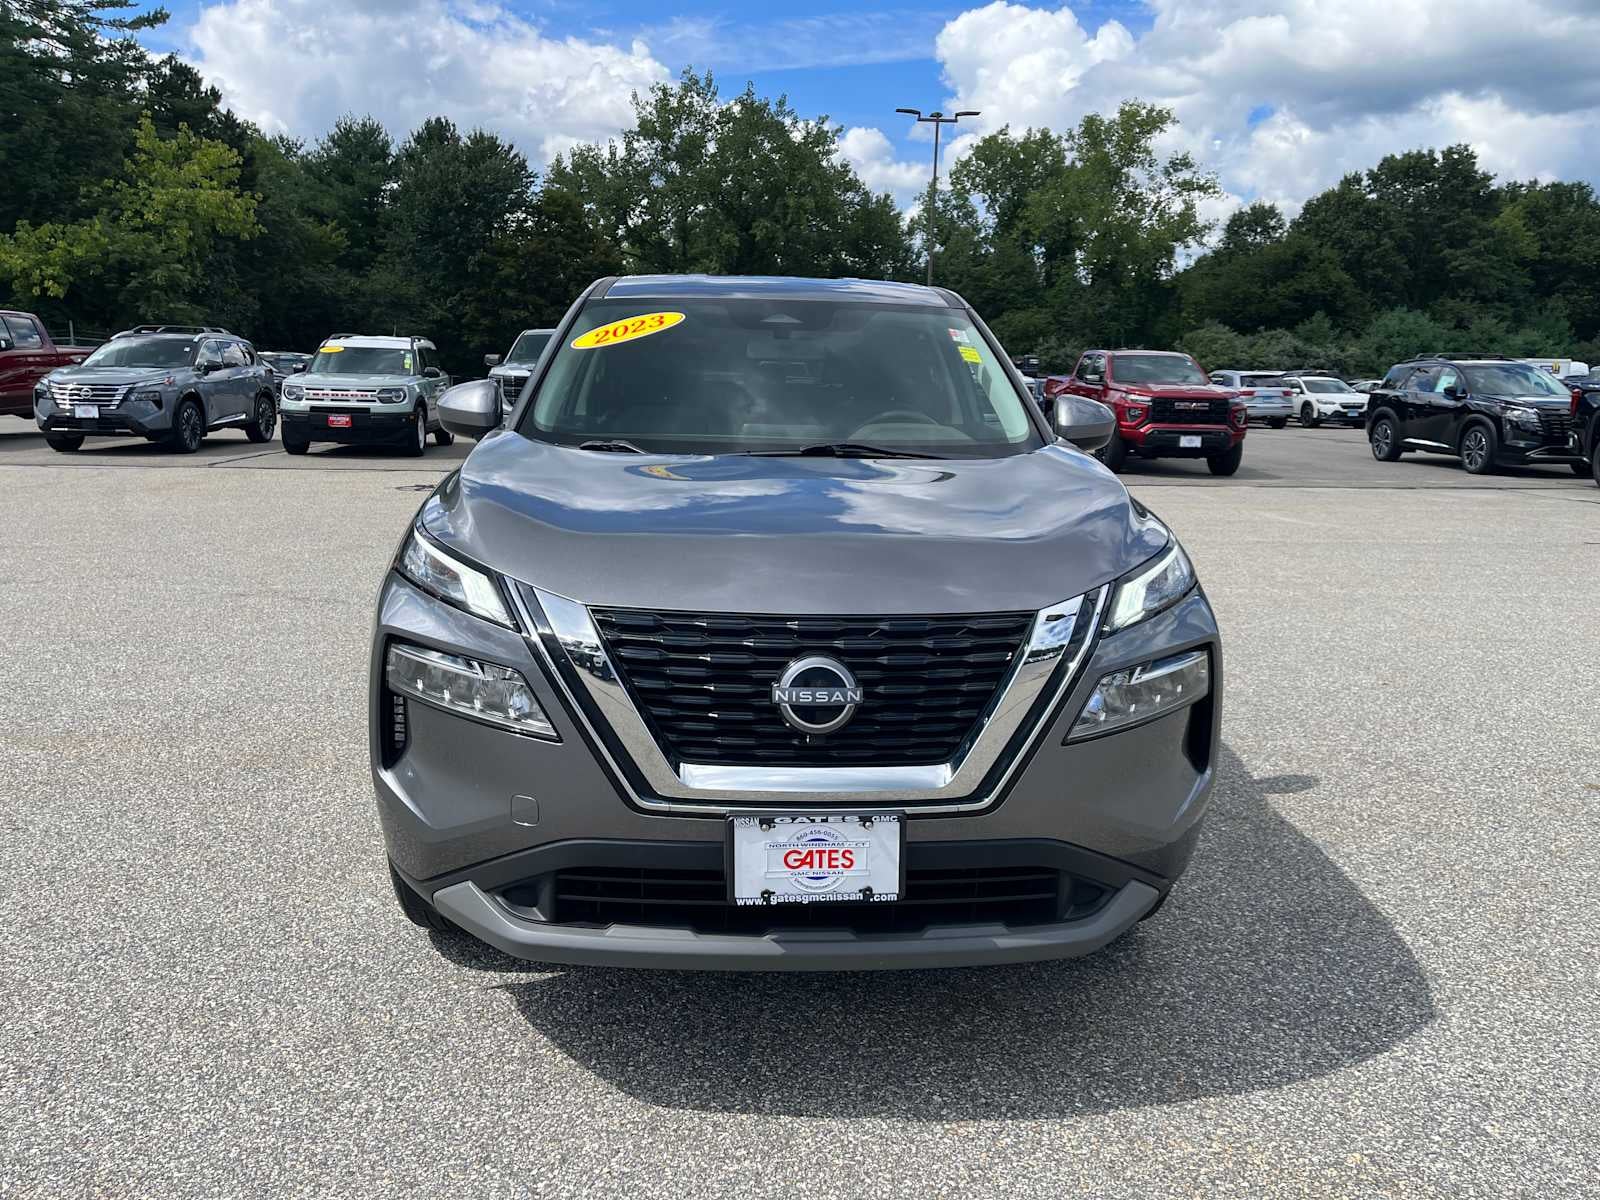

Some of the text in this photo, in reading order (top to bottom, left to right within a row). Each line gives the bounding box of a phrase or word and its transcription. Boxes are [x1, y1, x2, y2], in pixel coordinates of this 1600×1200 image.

[594, 315, 665, 344] 2023
[1174, 402, 1210, 410] GMC
[775, 690, 861, 702] NISSAN
[735, 816, 760, 826] NISSAN
[774, 816, 860, 824] GATES
[783, 849, 854, 869] GATES
[770, 891, 863, 905] gatesgmcnissan
